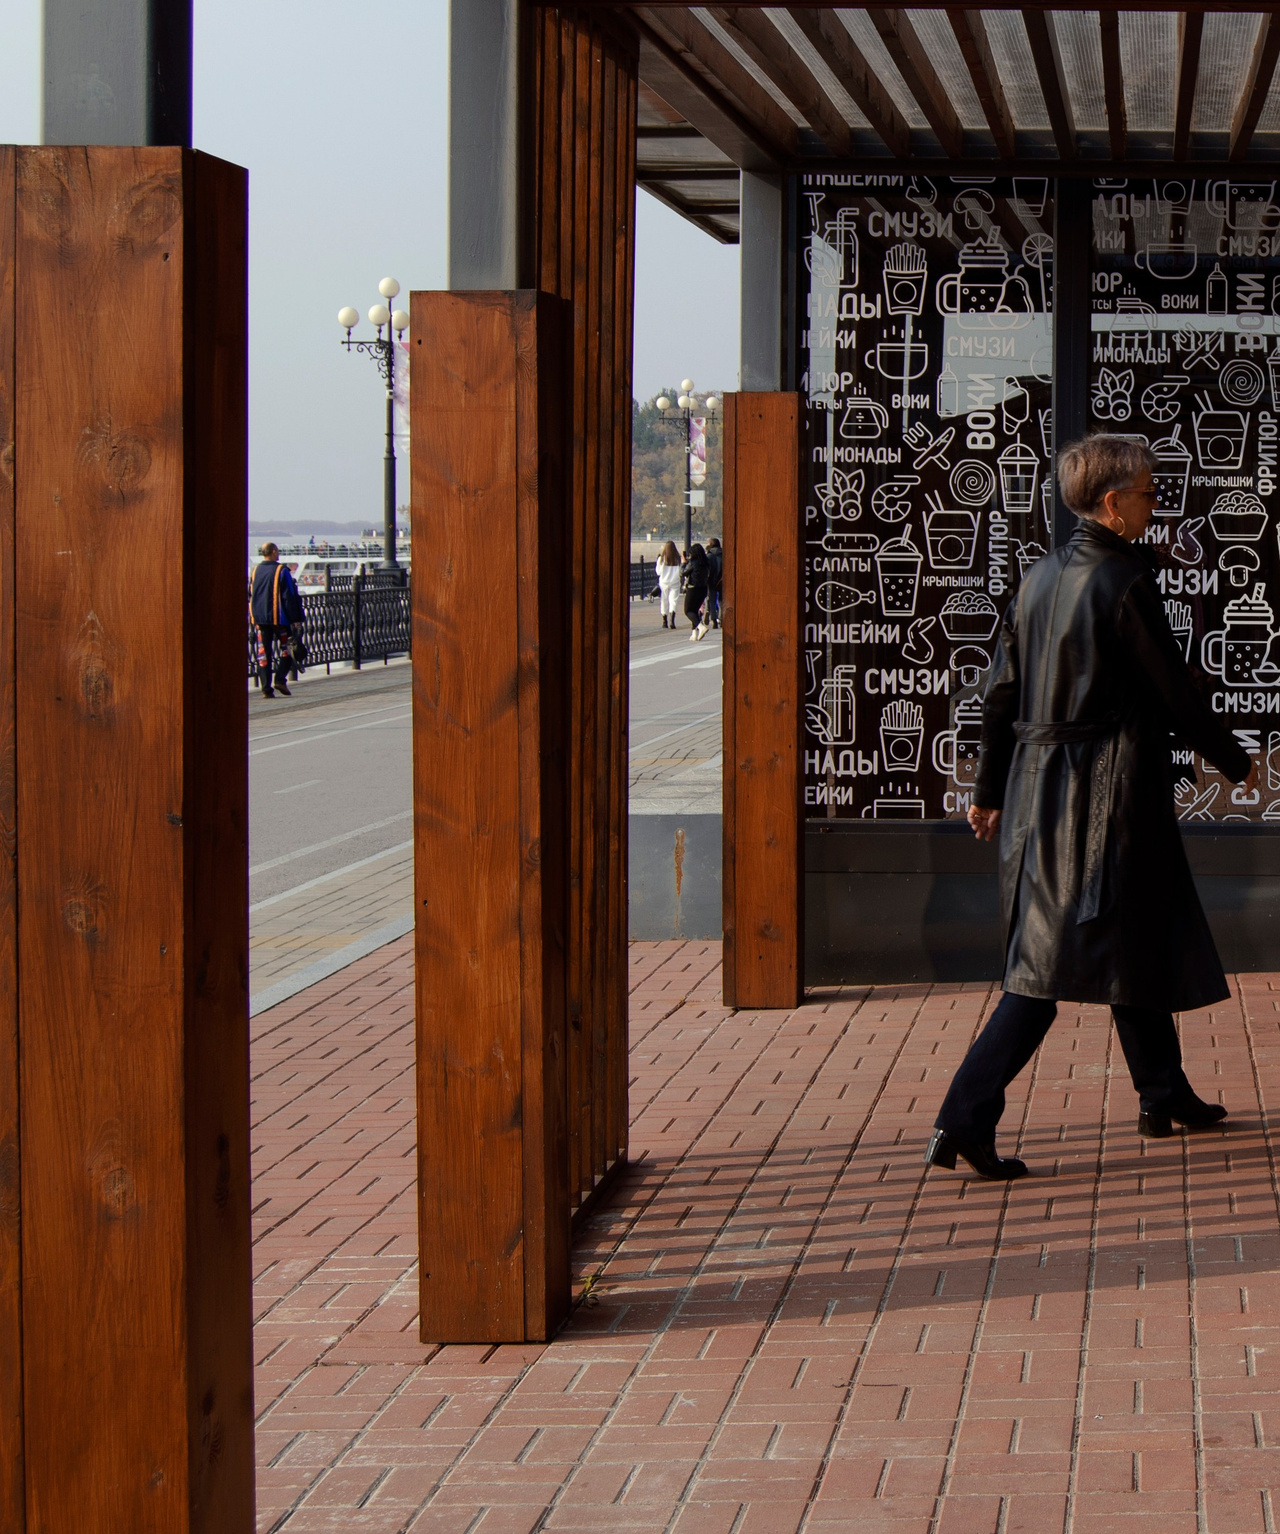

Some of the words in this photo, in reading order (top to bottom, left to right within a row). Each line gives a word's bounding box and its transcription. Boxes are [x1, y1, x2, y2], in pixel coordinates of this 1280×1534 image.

[868, 212, 953, 238] СМУЗИ
[1092, 272, 1122, 292] ЮР
[807, 293, 881, 321] НАДЫ
[1092, 299, 1111, 310] ТСЫ
[1161, 295, 1199, 309] ВОКИ
[1236, 273, 1265, 349] ВОКИ
[947, 337, 1014, 357] СМУЗИ
[1093, 347, 1170, 365] ИМОНАДЫ
[892, 395, 929, 409] ВОКИ
[967, 373, 996, 450] ВОКИ
[1257, 410, 1278, 495] ФРИТЮР
[989, 510, 1008, 596] ФРИТЮР
[813, 557, 870, 572] САЛАТЫ
[923, 576, 984, 586] КРЫЛЫШКИ
[865, 668, 949, 695] СМУЗИ
[1212, 692, 1280, 714] СМУЗИ
[805, 750, 878, 777] НАДЫ
[805, 782, 853, 805] ЕЙКИ
